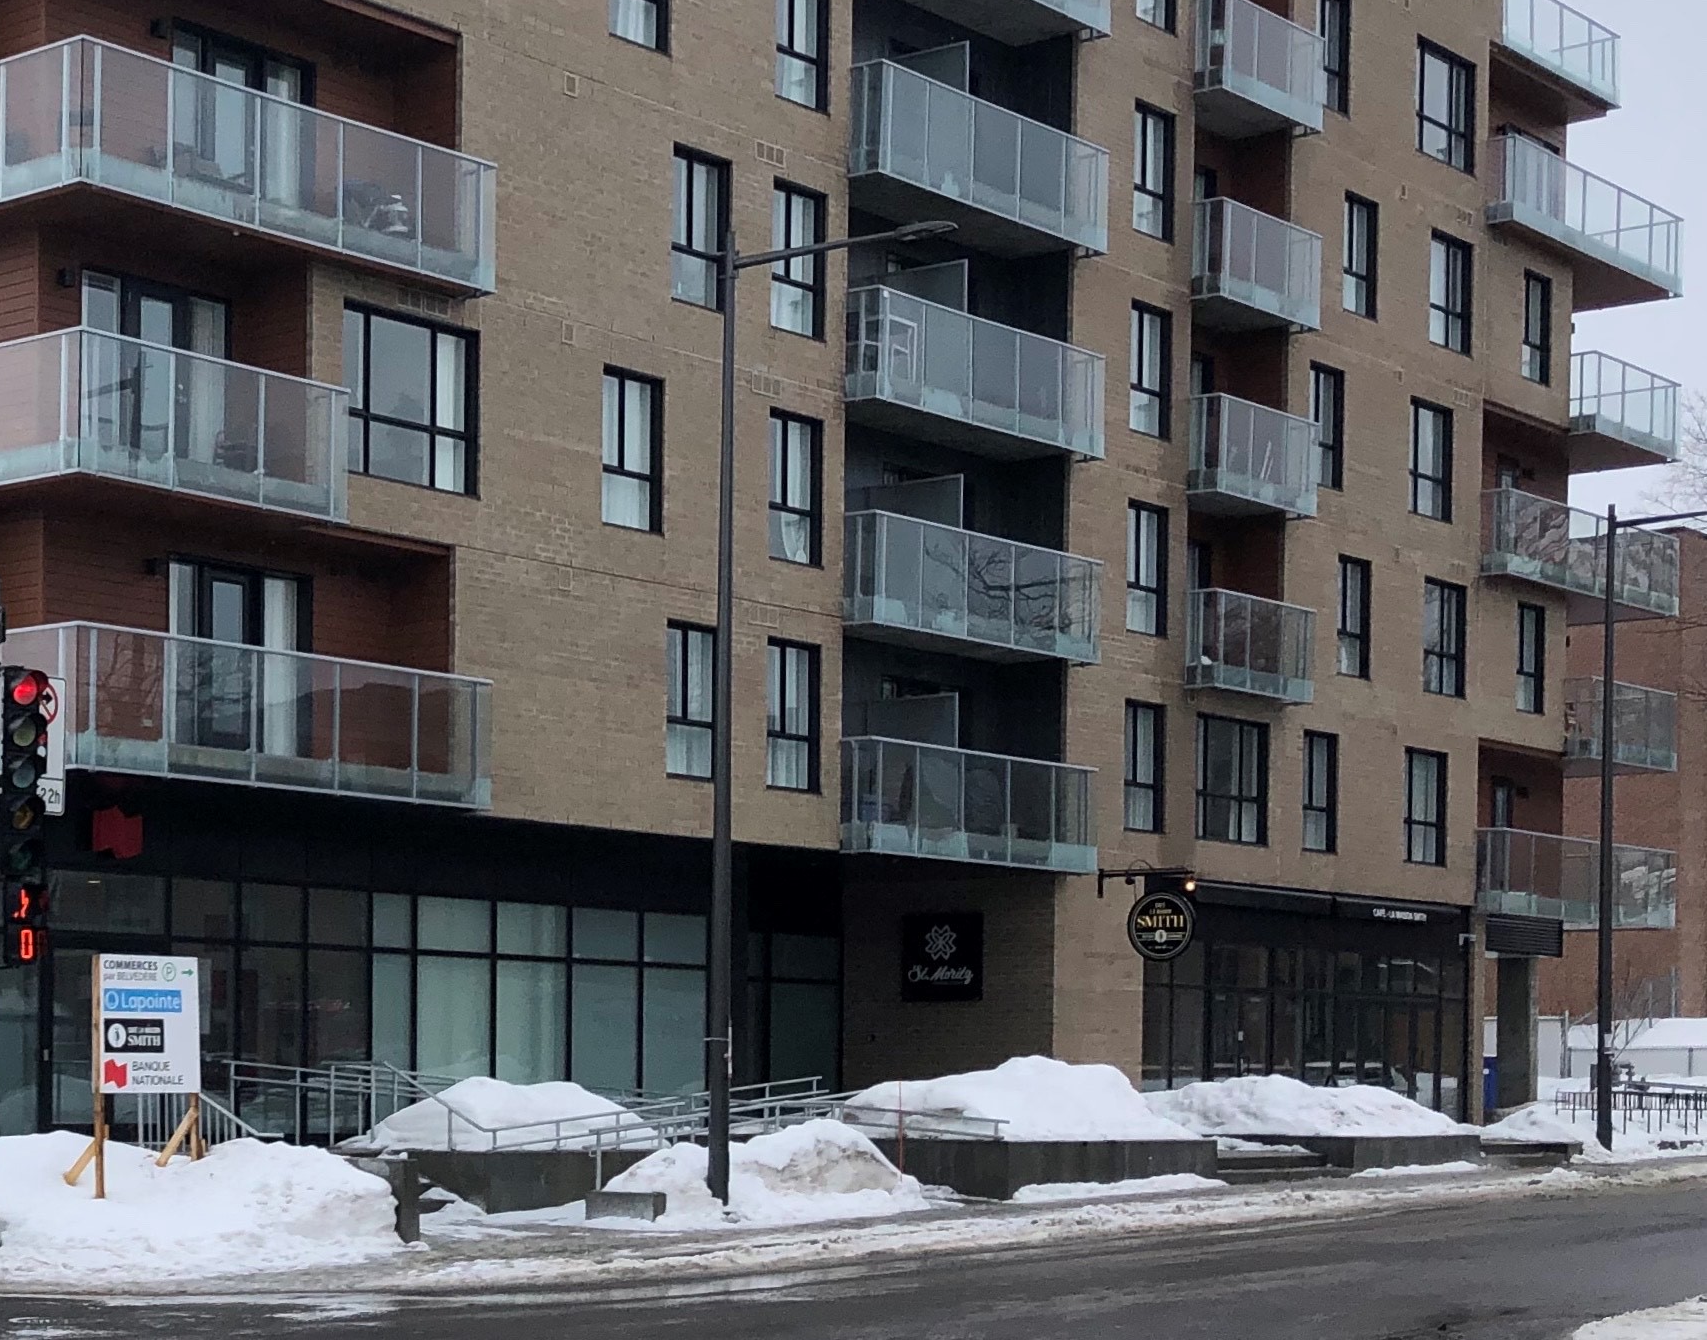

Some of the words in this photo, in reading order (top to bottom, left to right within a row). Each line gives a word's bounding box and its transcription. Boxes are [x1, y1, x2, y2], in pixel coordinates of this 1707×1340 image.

[1136, 914, 1184, 929] SMITH
[103, 960, 158, 971] COMMERCES
[121, 992, 181, 1011] Lapointe
[127, 1035, 161, 1046] SMITH
[132, 1061, 170, 1072] BANQUE
[132, 1075, 184, 1085] NATIONALE
